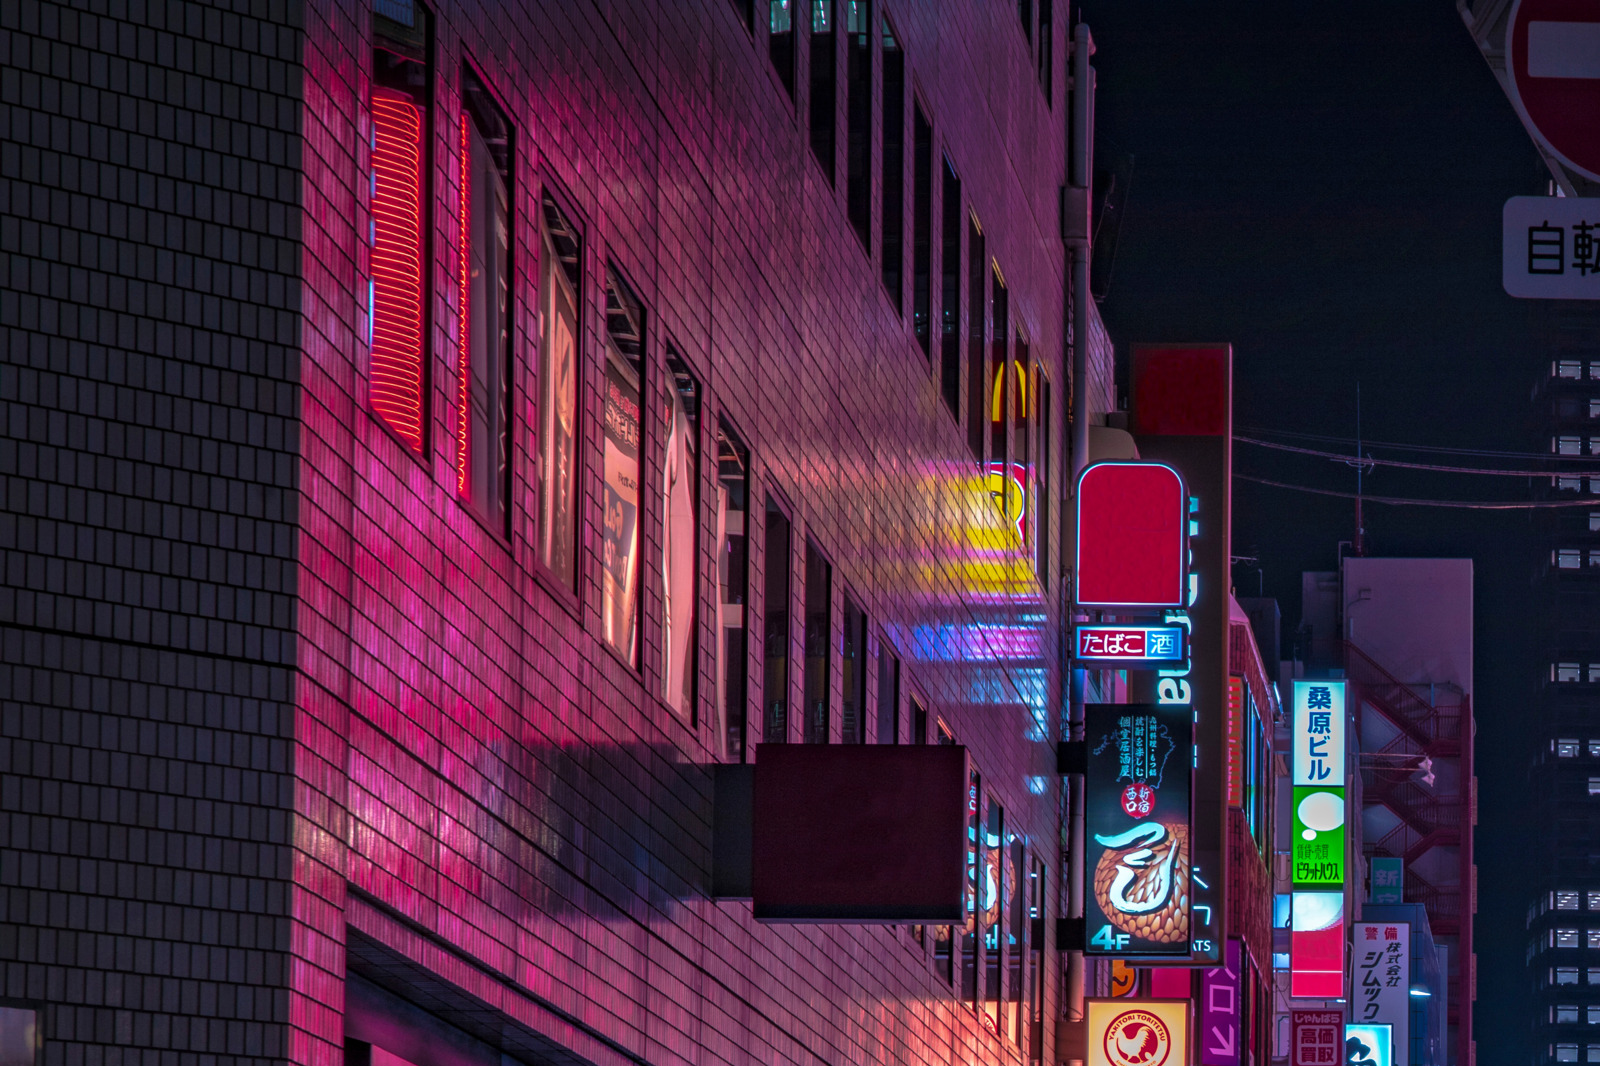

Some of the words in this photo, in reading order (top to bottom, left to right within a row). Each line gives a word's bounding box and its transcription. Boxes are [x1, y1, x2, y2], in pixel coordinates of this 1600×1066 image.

[1083, 633, 1143, 654] たばこ
[1150, 633, 1175, 654] 酒
[1307, 686, 1331, 781] 桑原ビル
[1125, 787, 1138, 812] 西口
[1138, 786, 1151, 812] 新宿
[1297, 862, 1339, 881] ピタットハウス
[1091, 925, 1131, 950] 4F
[1193, 941, 1211, 951] TS
[1365, 927, 1398, 941] 警備
[1385, 942, 1402, 988] 株式会社
[1360, 951, 1384, 1024] シムック
[1109, 1014, 1136, 1041] YAKITORI
[1137, 1013, 1166, 1042] TORITETSU
